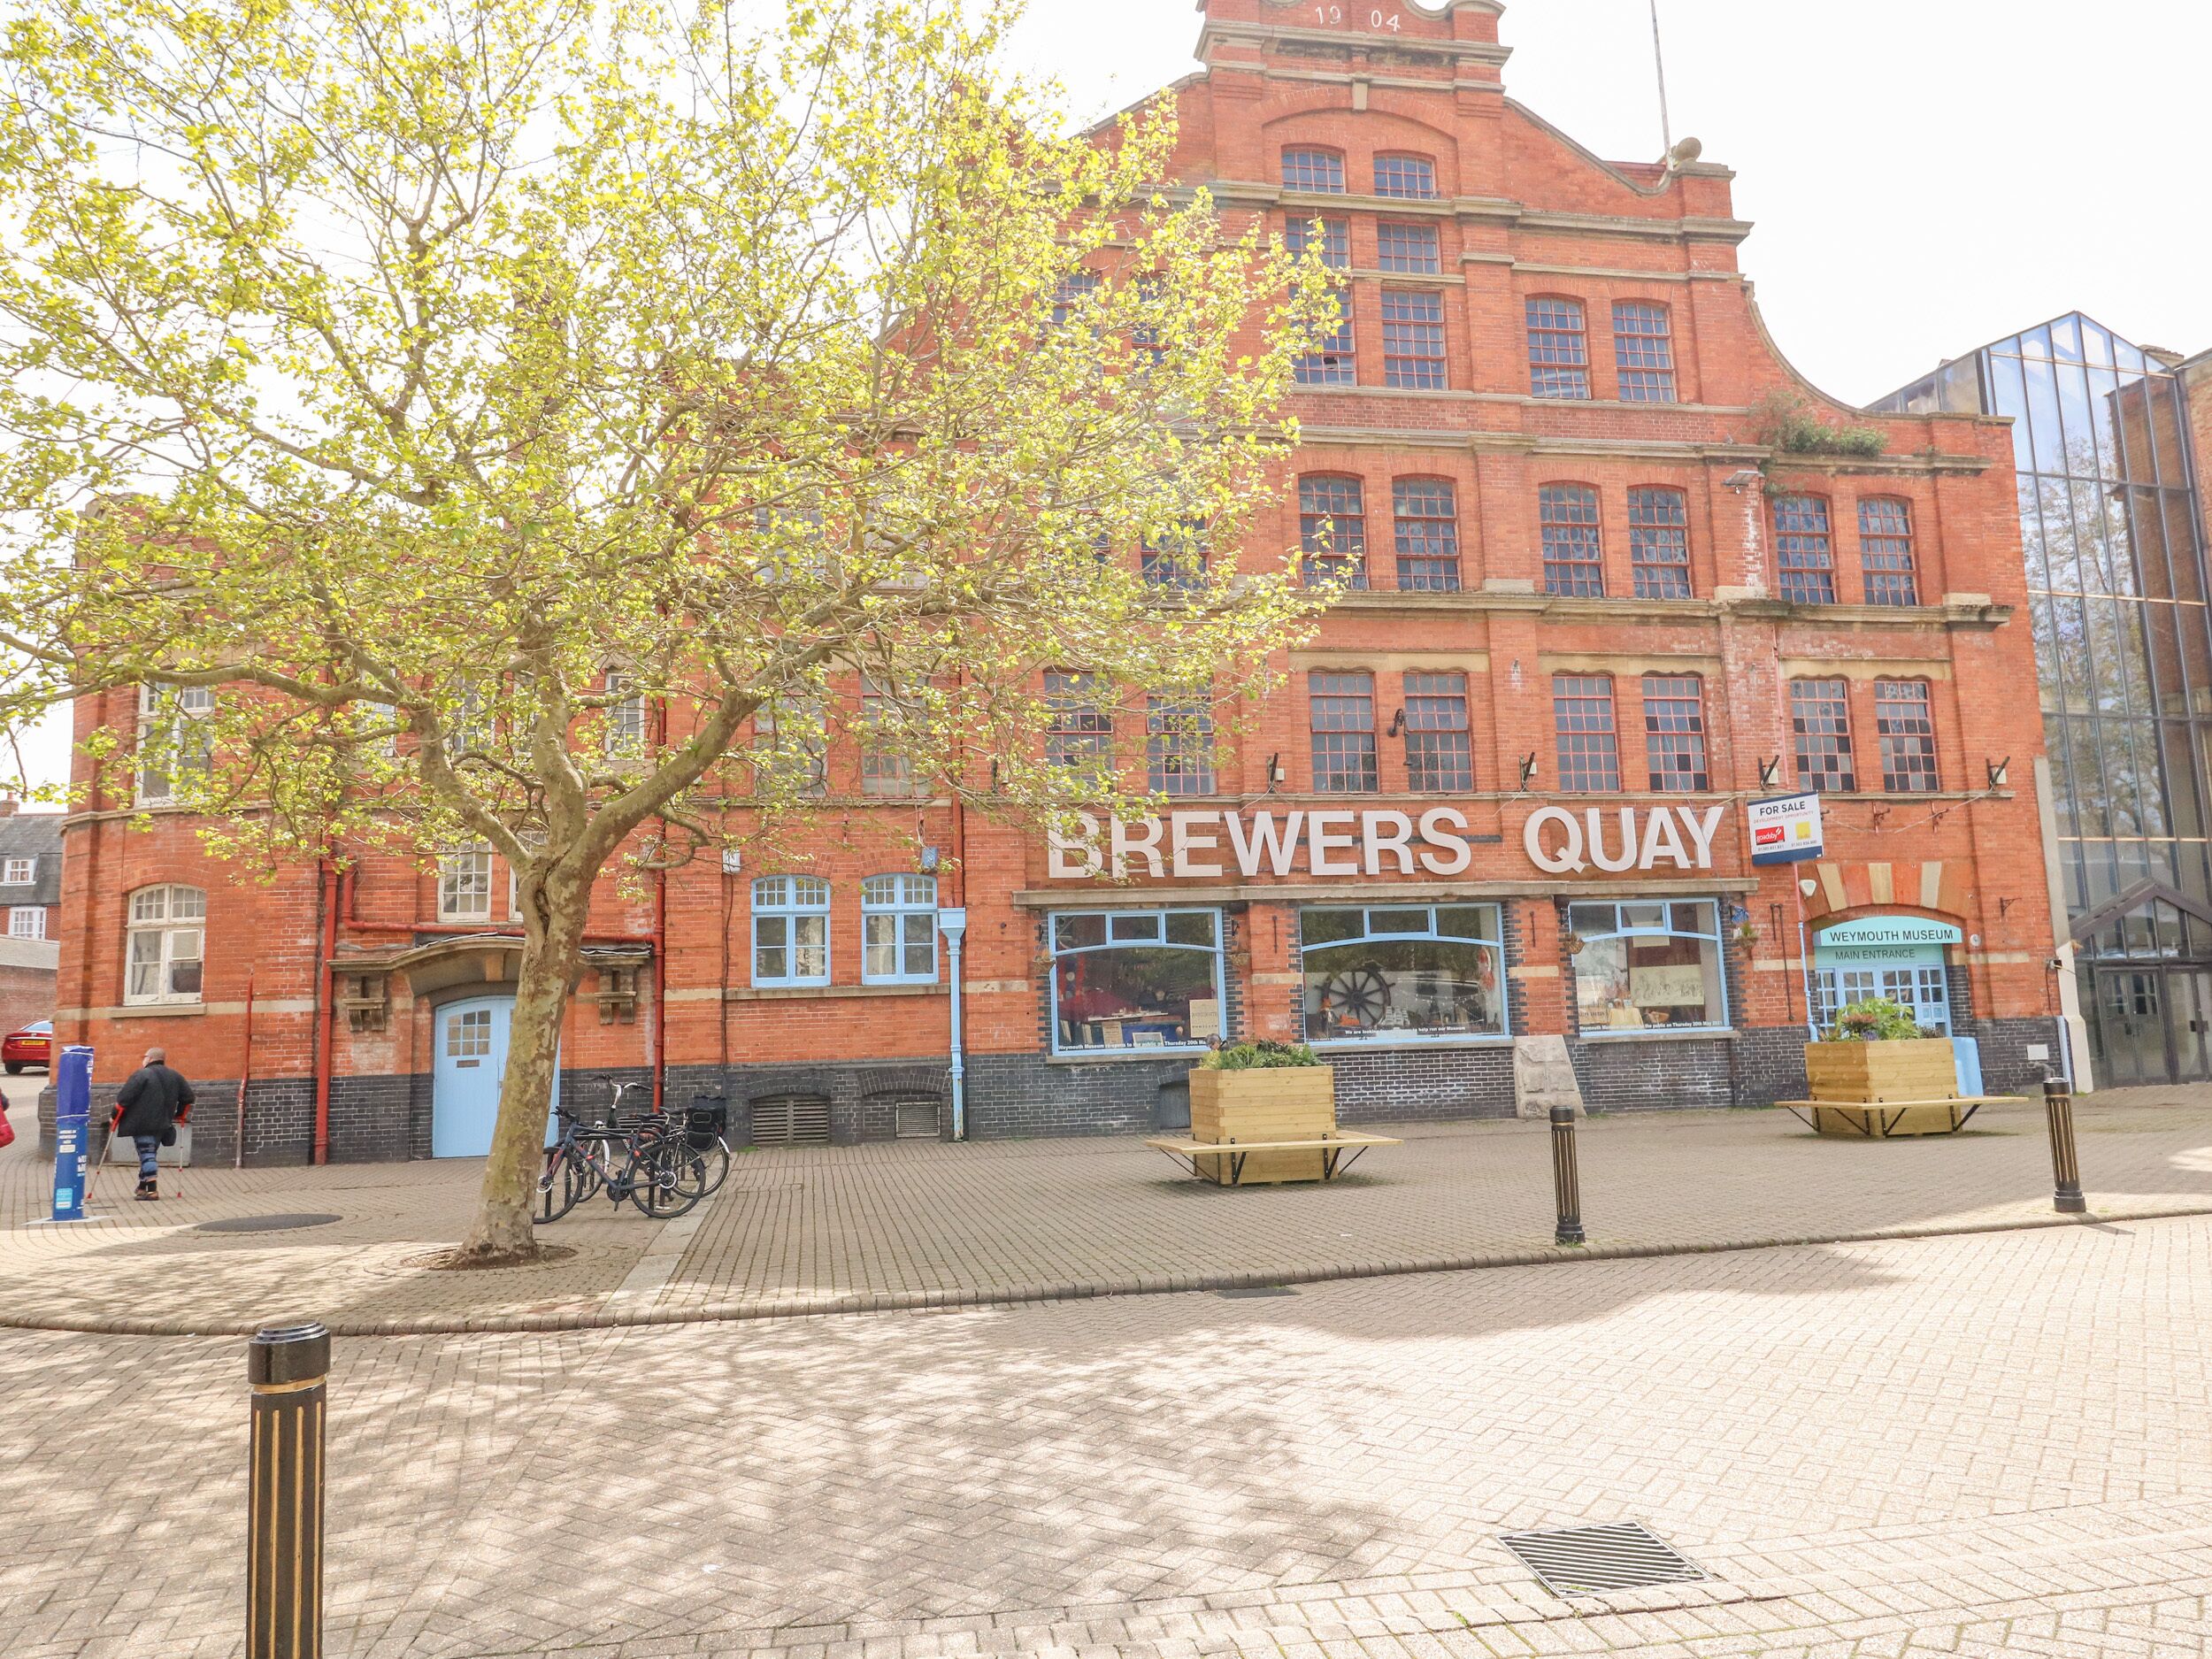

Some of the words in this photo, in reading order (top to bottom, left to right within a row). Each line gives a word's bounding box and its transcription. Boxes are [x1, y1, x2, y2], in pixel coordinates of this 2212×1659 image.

[1315, 6, 1342, 25] 19
[1371, 10, 1401, 32] 04
[1759, 805, 1779, 817] FOR
[1781, 801, 1806, 813] SALE
[1048, 807, 1471, 879] BREWERS
[1524, 805, 1724, 873] QUAY
[1830, 930, 1899, 943] WEYMOUTH
[1902, 929, 1954, 941] MUSEUM
[1835, 949, 1860, 960] MAIN
[1863, 949, 1916, 959] ENTRANCE
